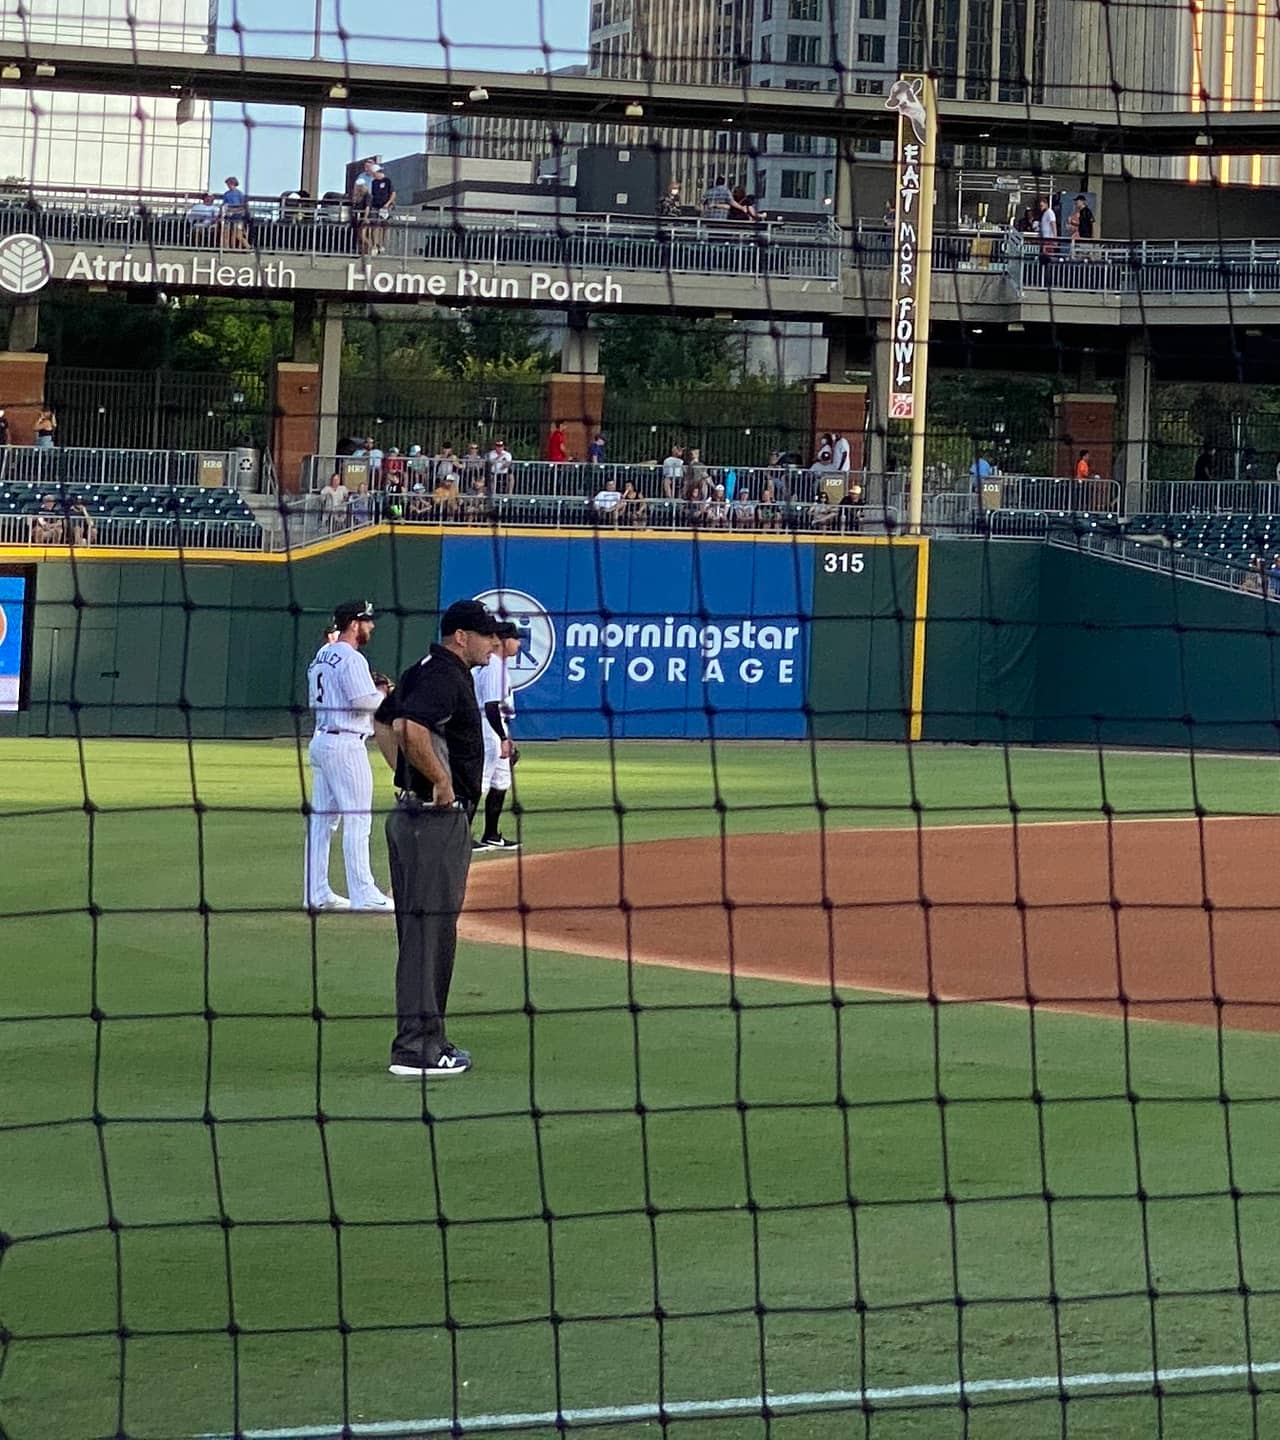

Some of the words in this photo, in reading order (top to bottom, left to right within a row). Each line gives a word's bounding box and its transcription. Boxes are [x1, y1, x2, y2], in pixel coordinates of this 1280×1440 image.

[900, 143, 920, 213] EAT
[65, 250, 185, 285] Atrium
[191, 256, 296, 289] Health
[899, 221, 917, 287] MOR
[346, 262, 447, 296] Home
[457, 268, 519, 299] Run
[530, 272, 623, 304] Porch
[894, 296, 914, 386] FOWL
[823, 552, 865, 573] 315
[565, 616, 800, 658] morningstar
[567, 656, 795, 685] STORAGE
